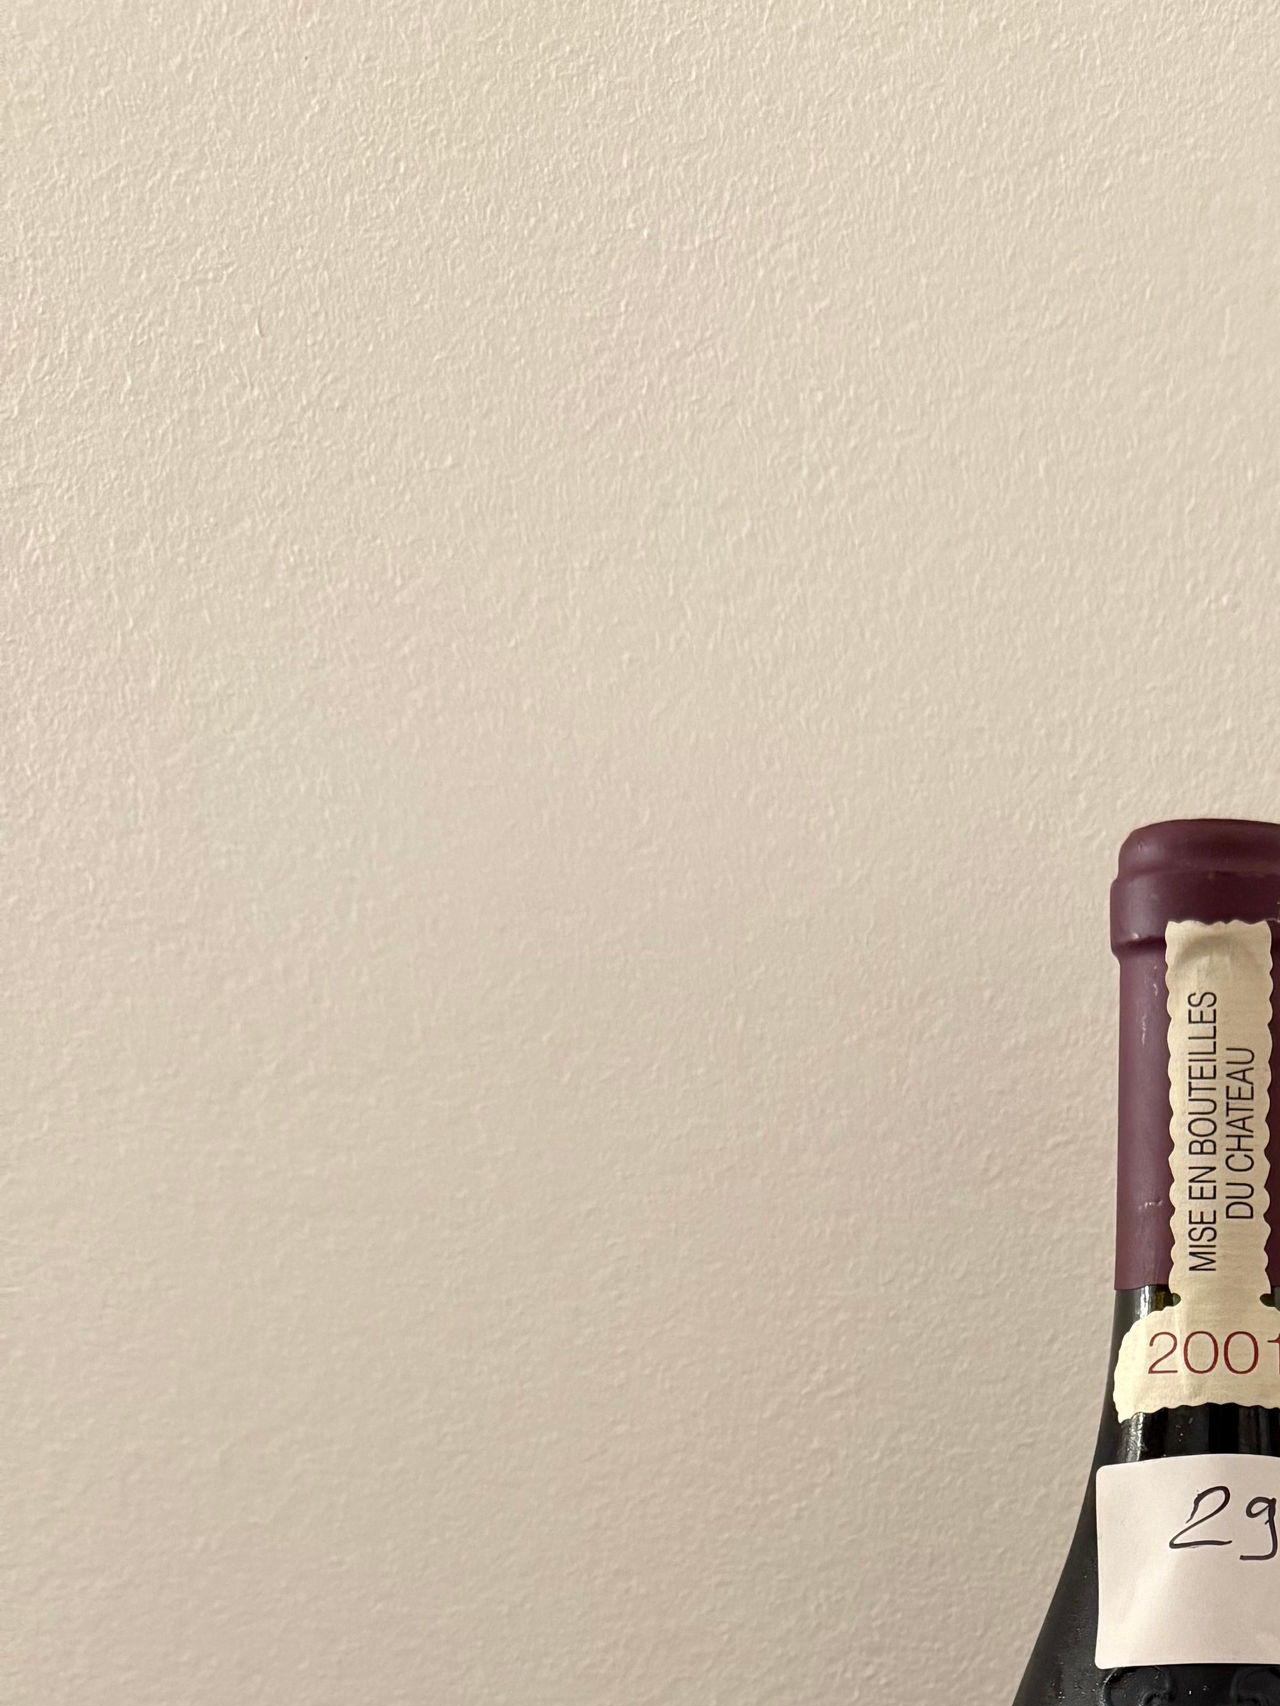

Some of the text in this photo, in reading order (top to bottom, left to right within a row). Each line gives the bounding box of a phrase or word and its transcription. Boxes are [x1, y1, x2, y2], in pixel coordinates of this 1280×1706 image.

[1187, 991, 1217, 1272] MISE EN BOUTEILLES
[1225, 1047, 1254, 1220] DU CHATEAU
